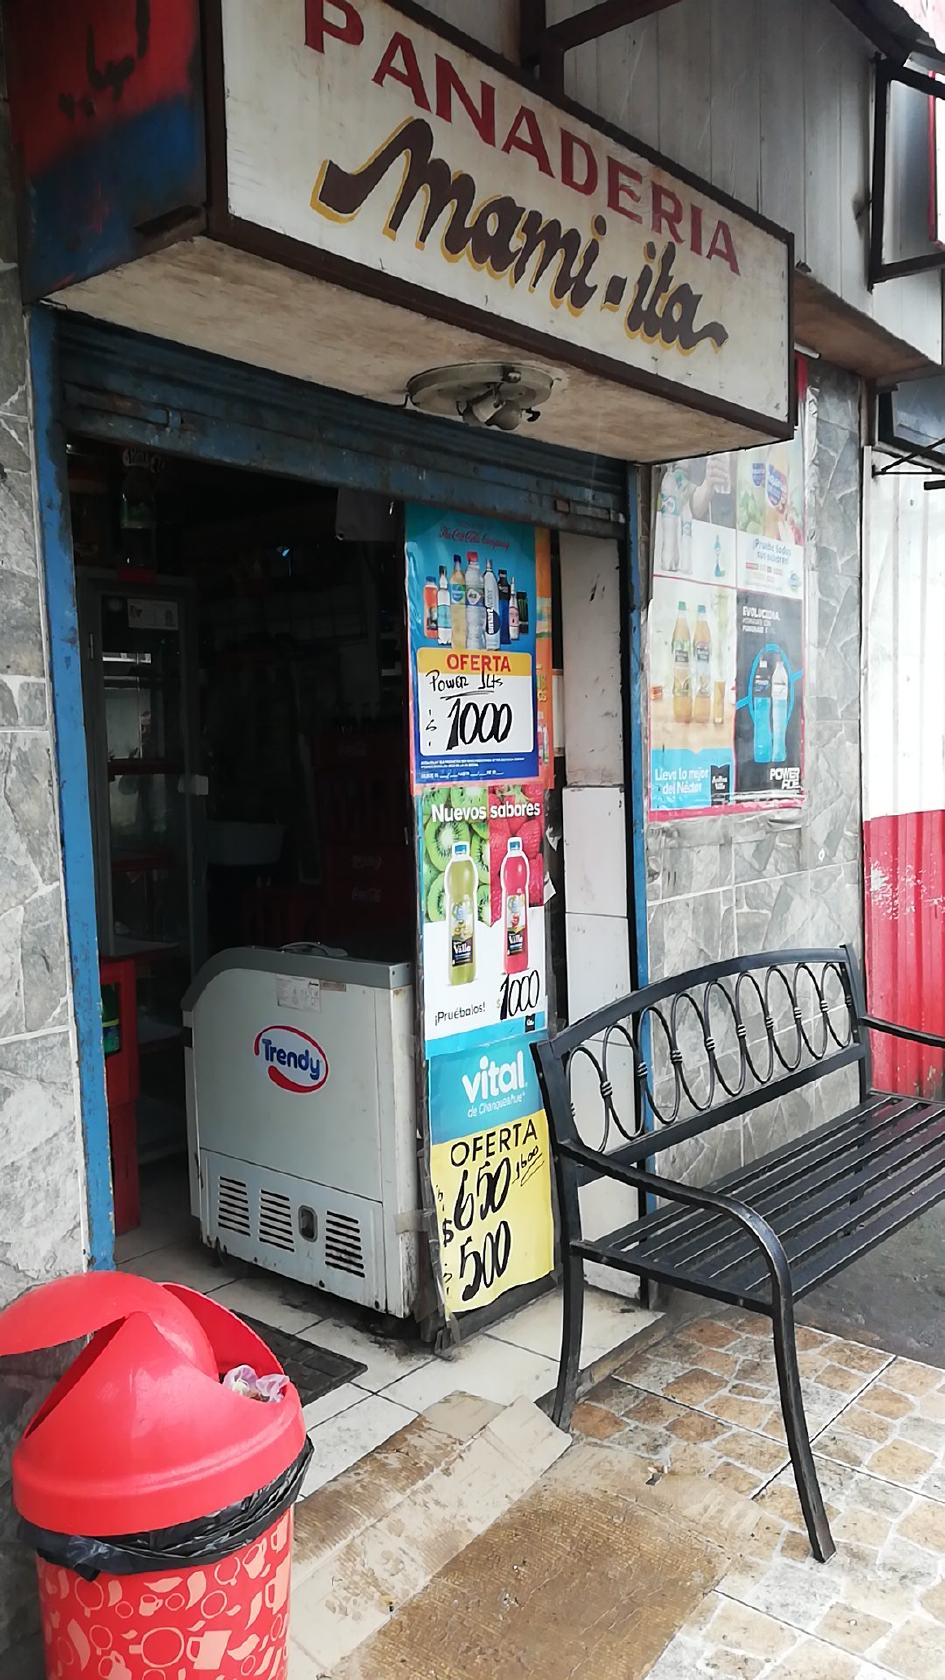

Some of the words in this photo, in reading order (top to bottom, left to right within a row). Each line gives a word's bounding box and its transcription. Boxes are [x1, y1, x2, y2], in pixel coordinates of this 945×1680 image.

[304, 0, 742, 276] PANADERIA
[446, 653, 512, 672] OFERTA
[446, 698, 512, 751] 1000
[431, 803, 486, 822] Nuevos
[490, 802, 541, 819] sabores
[434, 1001, 486, 1027] ¡Pruébalos!
[499, 970, 540, 1021] 1000
[261, 1038, 320, 1081] Trendy
[461, 1050, 525, 1104] vital
[467, 1105, 478, 1118] de
[450, 1119, 538, 1167] OFERTA
[459, 1220, 511, 1302] 500
